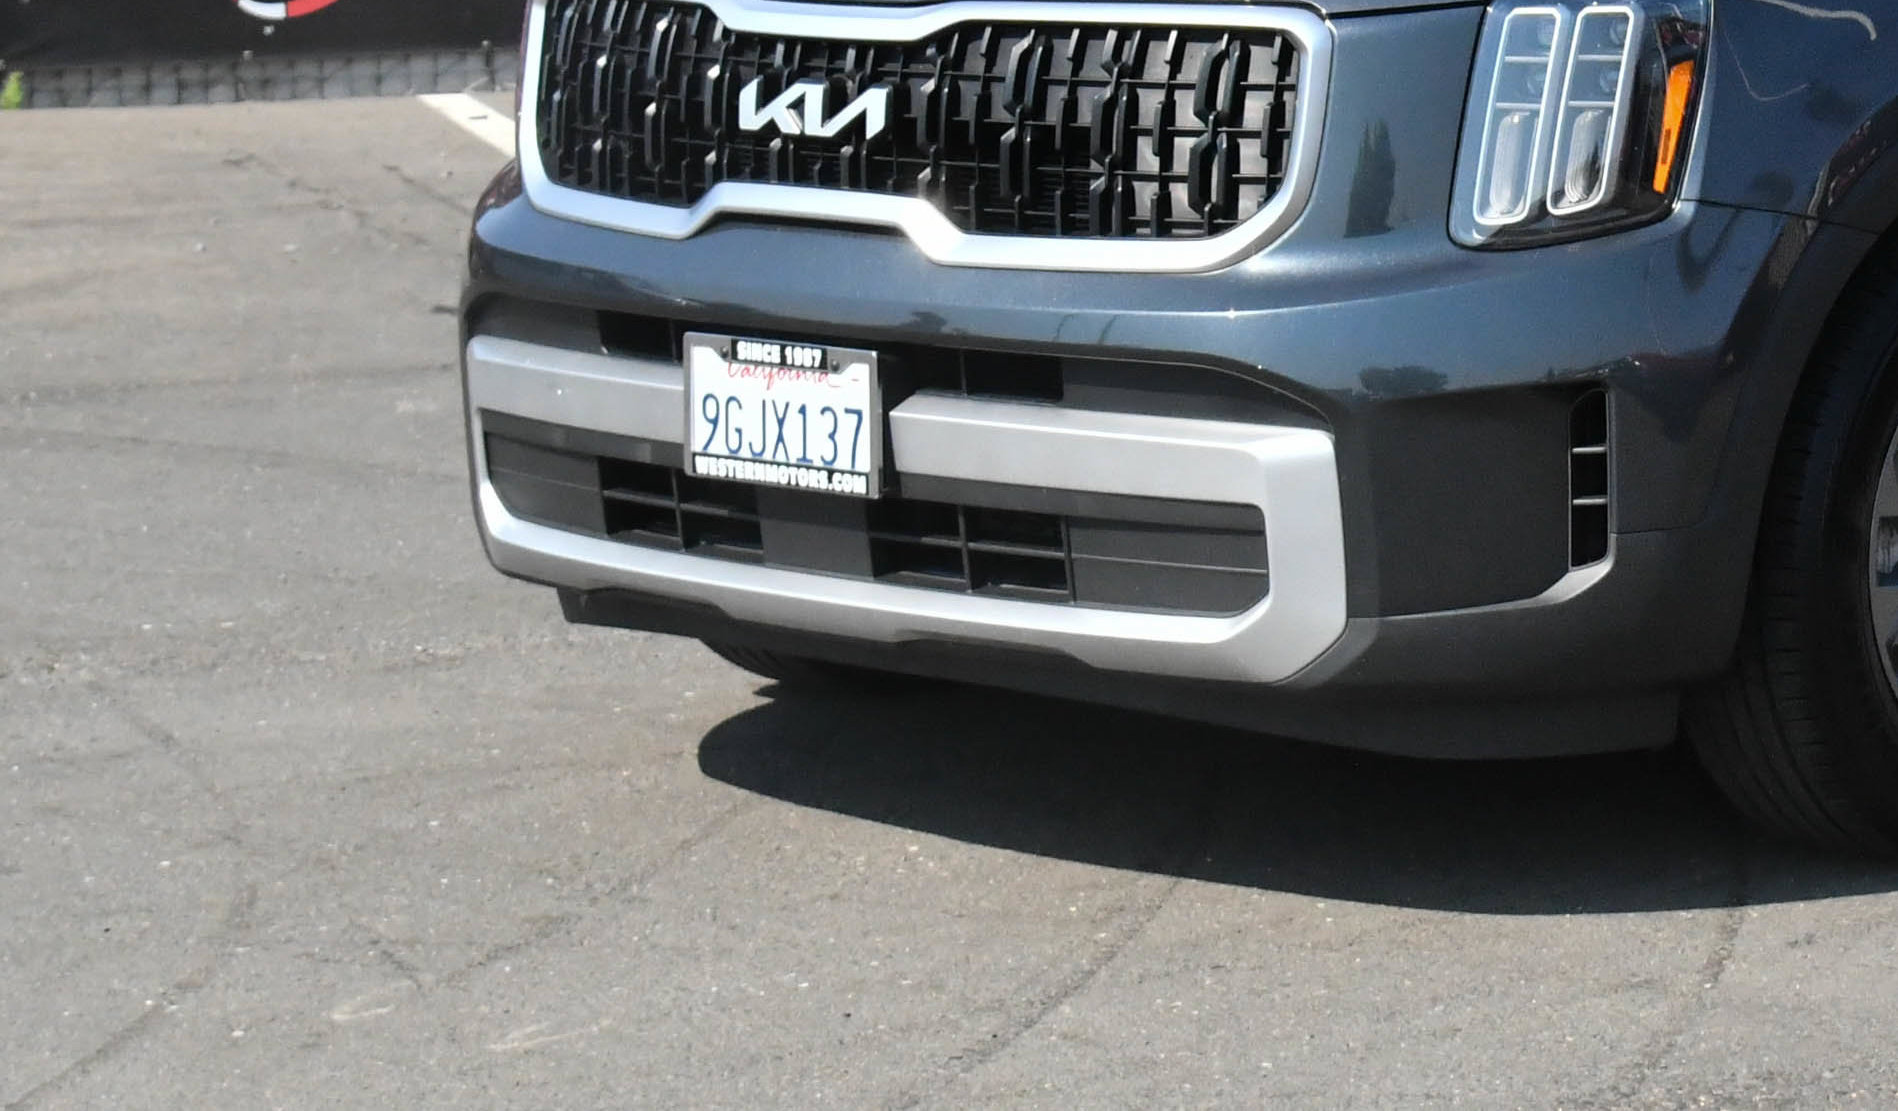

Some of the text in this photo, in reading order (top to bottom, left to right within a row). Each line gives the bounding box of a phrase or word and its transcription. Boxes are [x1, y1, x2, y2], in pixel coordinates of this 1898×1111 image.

[739, 76, 890, 140] KIA
[737, 341, 781, 364] SINCE
[701, 393, 864, 470] 9GJX137
